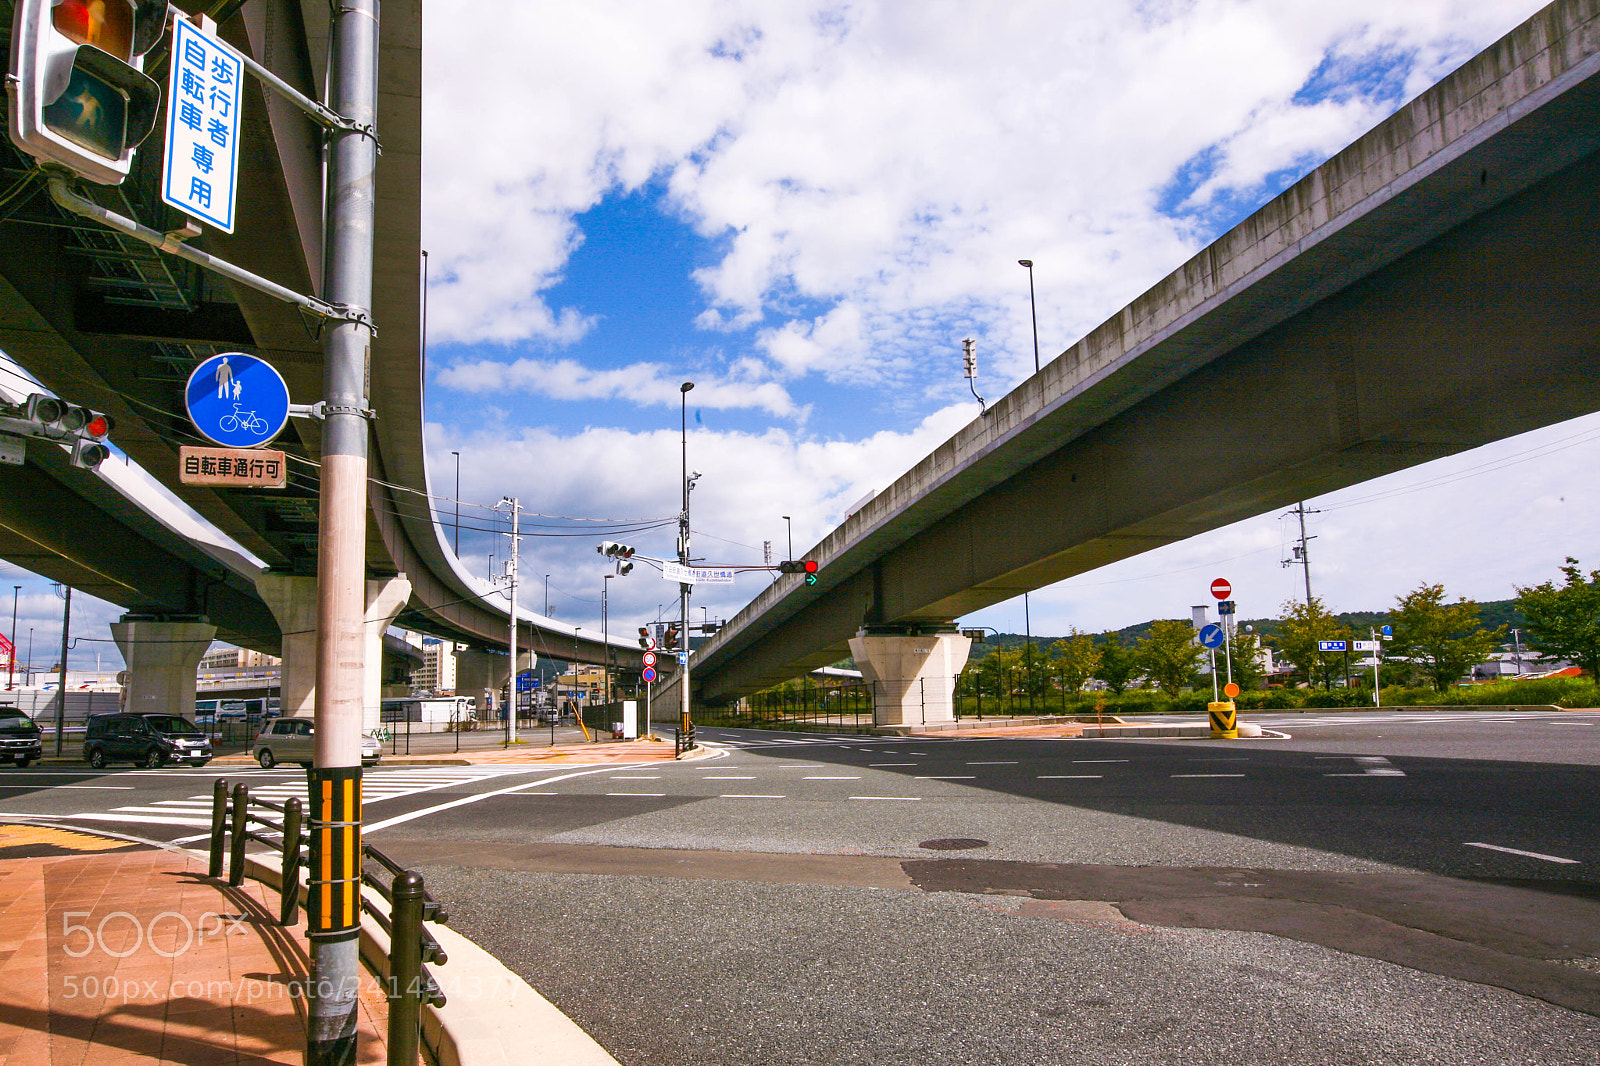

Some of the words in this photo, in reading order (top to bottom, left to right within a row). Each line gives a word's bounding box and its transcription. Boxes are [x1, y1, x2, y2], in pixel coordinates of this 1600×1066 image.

[179, 38, 206, 133] 自転車
[207, 55, 234, 148] 歩行者
[188, 142, 215, 209] 専用
[185, 455, 280, 479] 自転車通行可
